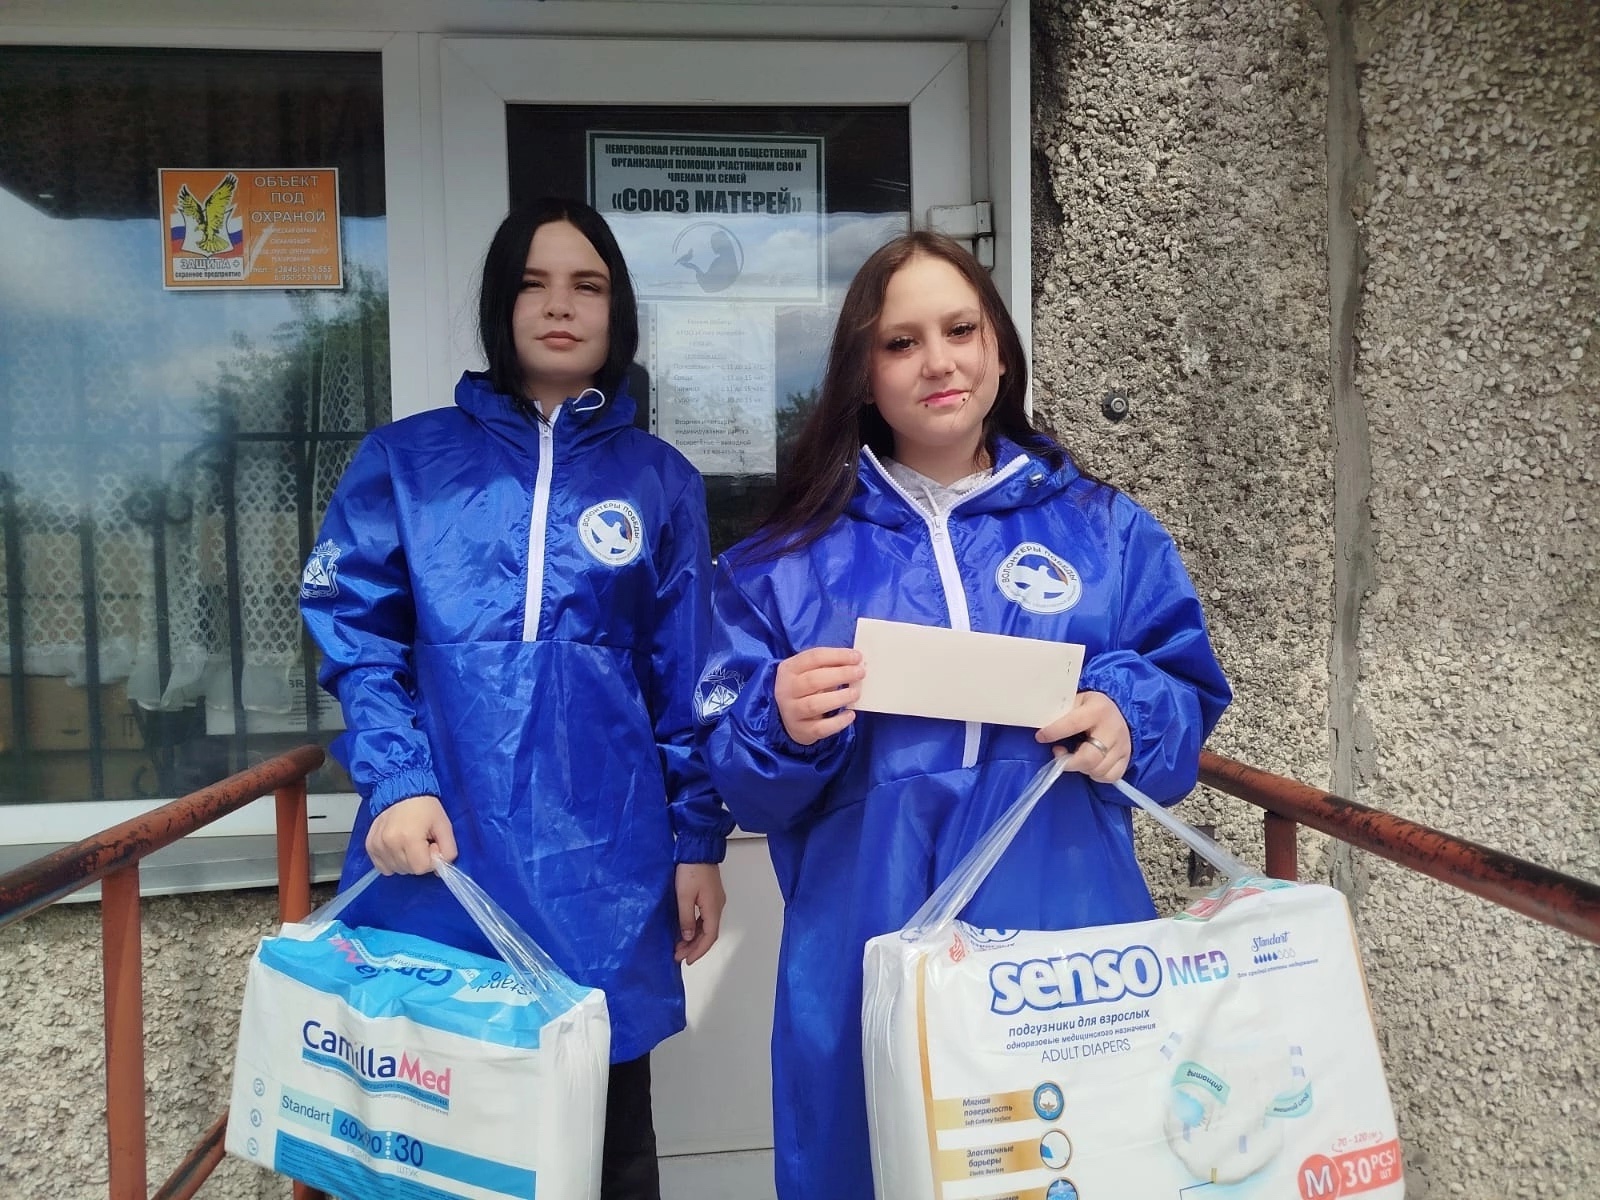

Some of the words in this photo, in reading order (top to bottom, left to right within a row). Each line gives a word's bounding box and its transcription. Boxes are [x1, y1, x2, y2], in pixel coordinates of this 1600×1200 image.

[605, 144, 668, 155] КЕМЕРОВСКАЯ
[670, 146, 736, 157] РЕГИОНАЛЬНАЯ
[738, 148, 807, 159] ОБЩЕСТВЕННАЯ
[611, 157, 673, 170] ОРГАНИЗАЦИЯ
[675, 159, 715, 171] ПОМОЩИ
[717, 160, 774, 171] УЧАСТНИКАМ
[776, 161, 794, 172] СВО
[796, 162, 802, 172] И
[254, 175, 319, 187] ОБЪЕКТ
[668, 172, 704, 183] ЧЛЕНАМ
[705, 173, 717, 183] ИХ
[718, 172, 746, 184] СЕМЕЙ
[271, 192, 305, 204] ПОД
[612, 188, 689, 213] «СОЮЗ
[695, 187, 802, 214] МАТЕРЕЙ»
[251, 209, 326, 223] ОХРАНОЙ
[180, 259, 231, 270] ЗАЩИТА
[582, 502, 620, 527] ВОЛОНТЕРЫ
[623, 506, 640, 539] ПОБЕДЫ
[1001, 545, 1042, 583] ВОЛОНТЕРЫ
[1251, 931, 1290, 952] Standart
[989, 944, 1162, 1015] senso
[1166, 950, 1229, 987] MED
[1008, 1020, 1075, 1037] подгузники
[1078, 1016, 1097, 1028] для
[1099, 1009, 1150, 1026] взрослых
[1006, 1036, 1060, 1050] одноразовые
[1061, 1030, 1113, 1044] медицинского
[1114, 1023, 1156, 1036] назначения
[1041, 1046, 1079, 1063] ADULT
[1082, 1038, 1131, 1057] DIAPERS
[282, 1095, 331, 1125] Standart
[964, 1105, 1013, 1117] поверхность
[394, 1134, 424, 1168] 30
[968, 1158, 1002, 1168] барьеры
[1342, 1157, 1372, 1188] 30
